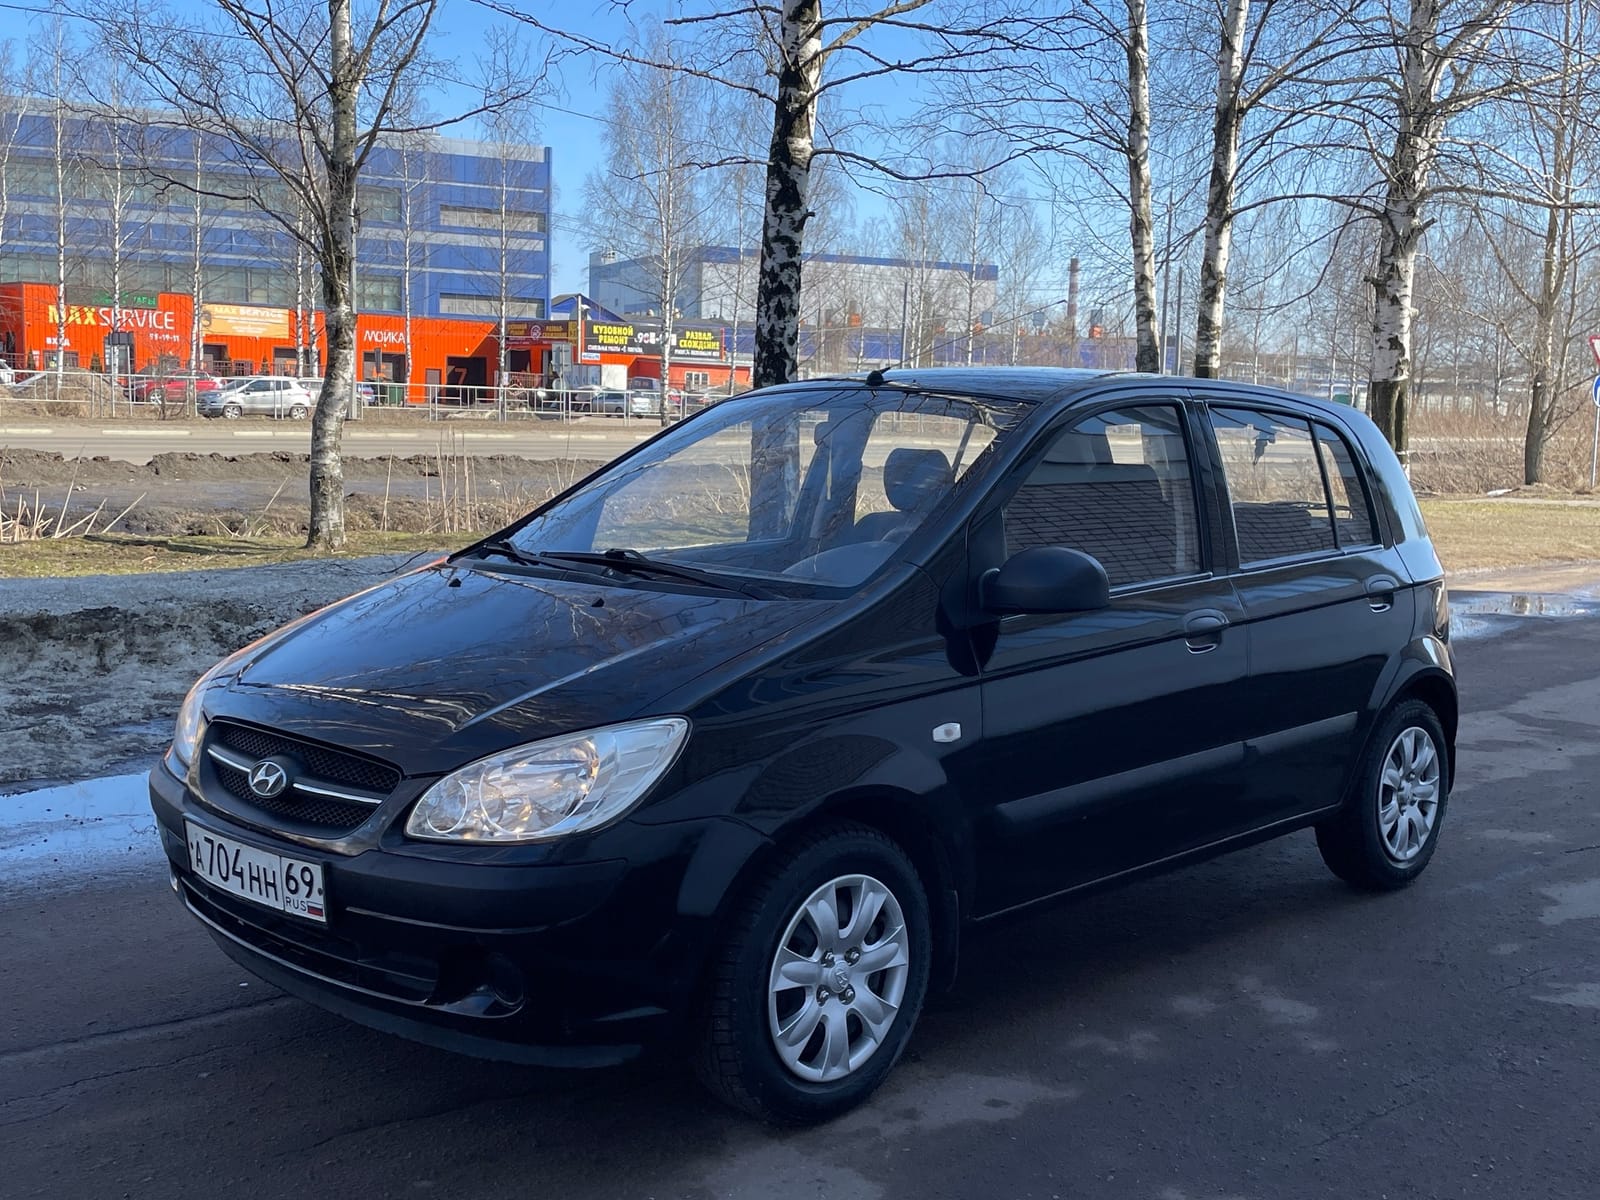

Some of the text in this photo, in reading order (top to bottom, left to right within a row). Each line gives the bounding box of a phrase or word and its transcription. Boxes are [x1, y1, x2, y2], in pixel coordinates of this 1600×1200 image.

[48, 304, 175, 330] MAX SERVICE
[363, 329, 406, 345] МОЙКА
[593, 324, 634, 336] КУЗОВНОЙ
[598, 334, 629, 345] РЕМОНТ
[195, 835, 315, 902] А704НН 69
[285, 896, 308, 912] RUS
